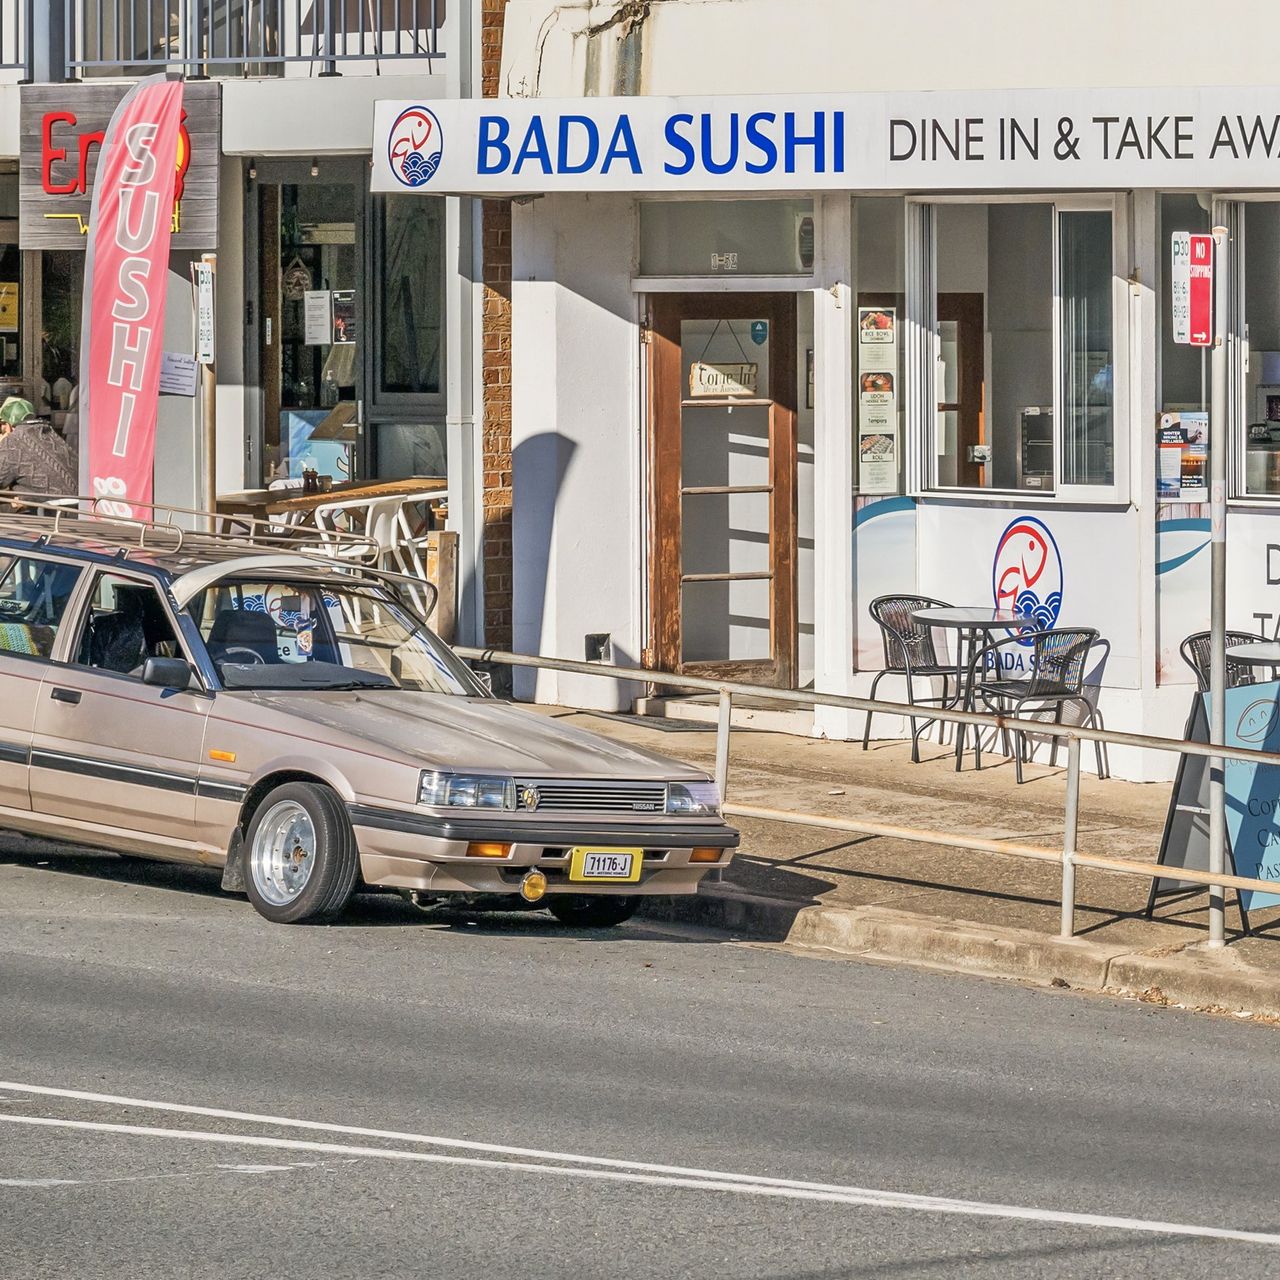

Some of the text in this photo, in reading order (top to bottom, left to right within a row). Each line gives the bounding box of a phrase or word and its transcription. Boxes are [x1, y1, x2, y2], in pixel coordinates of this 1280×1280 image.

[476, 114, 643, 175] BADA
[664, 110, 845, 176] SUSHI
[889, 118, 985, 162] DINE
[999, 117, 1039, 161] IN
[1053, 116, 1081, 161] &
[1092, 115, 1194, 160] TAKE
[1195, 242, 1206, 259] NO
[1190, 265, 1211, 278] STOPPING
[108, 122, 160, 458] SUSHI
[986, 651, 1025, 671] BADA
